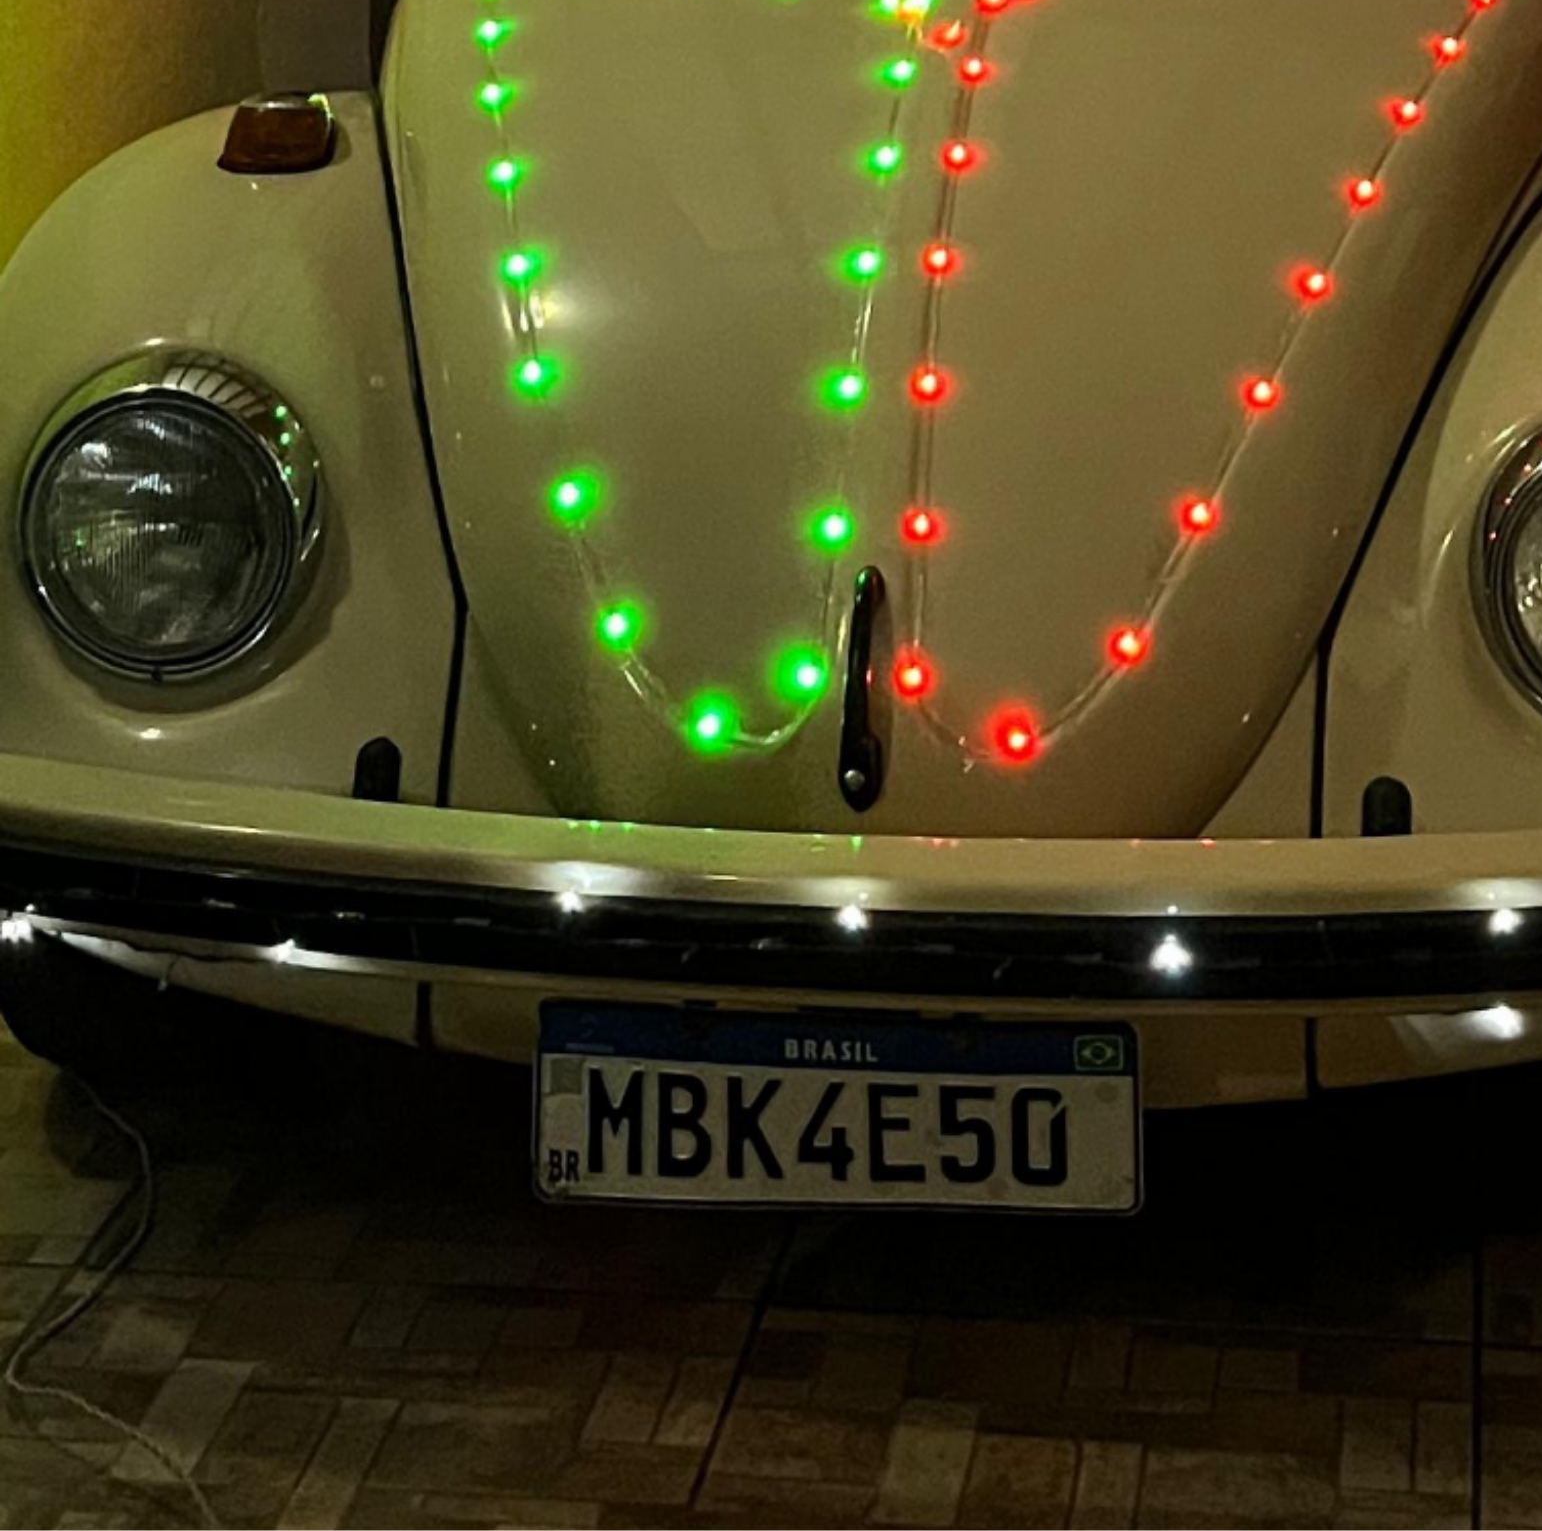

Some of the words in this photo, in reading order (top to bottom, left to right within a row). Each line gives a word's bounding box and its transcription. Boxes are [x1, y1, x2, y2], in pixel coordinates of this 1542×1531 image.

[785, 1039, 879, 1063] BRASIL
[588, 1069, 1068, 1187] MBK4E50
[547, 1148, 580, 1183] BR
